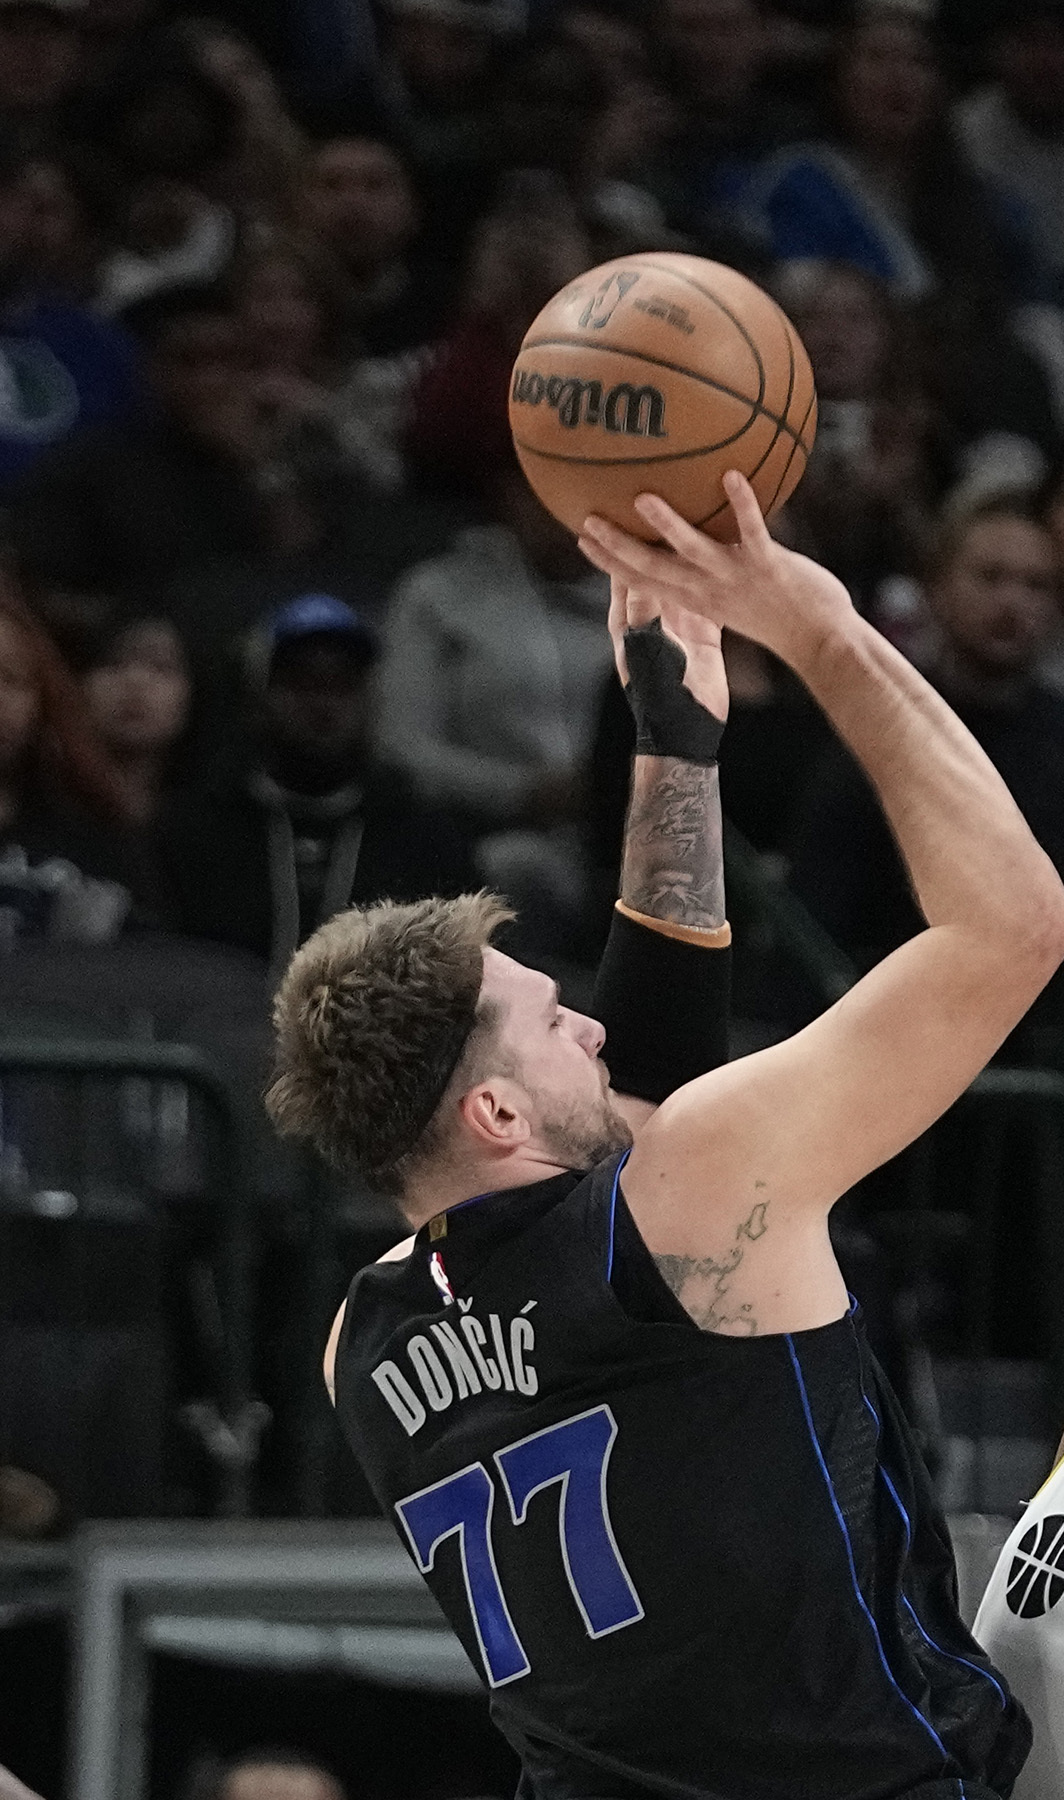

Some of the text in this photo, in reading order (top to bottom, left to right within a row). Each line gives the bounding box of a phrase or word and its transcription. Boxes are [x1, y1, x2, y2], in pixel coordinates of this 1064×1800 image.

[512, 368, 668, 438] Wilson
[371, 1296, 539, 1437] DONČIĆ
[394, 1403, 645, 1689] 77
